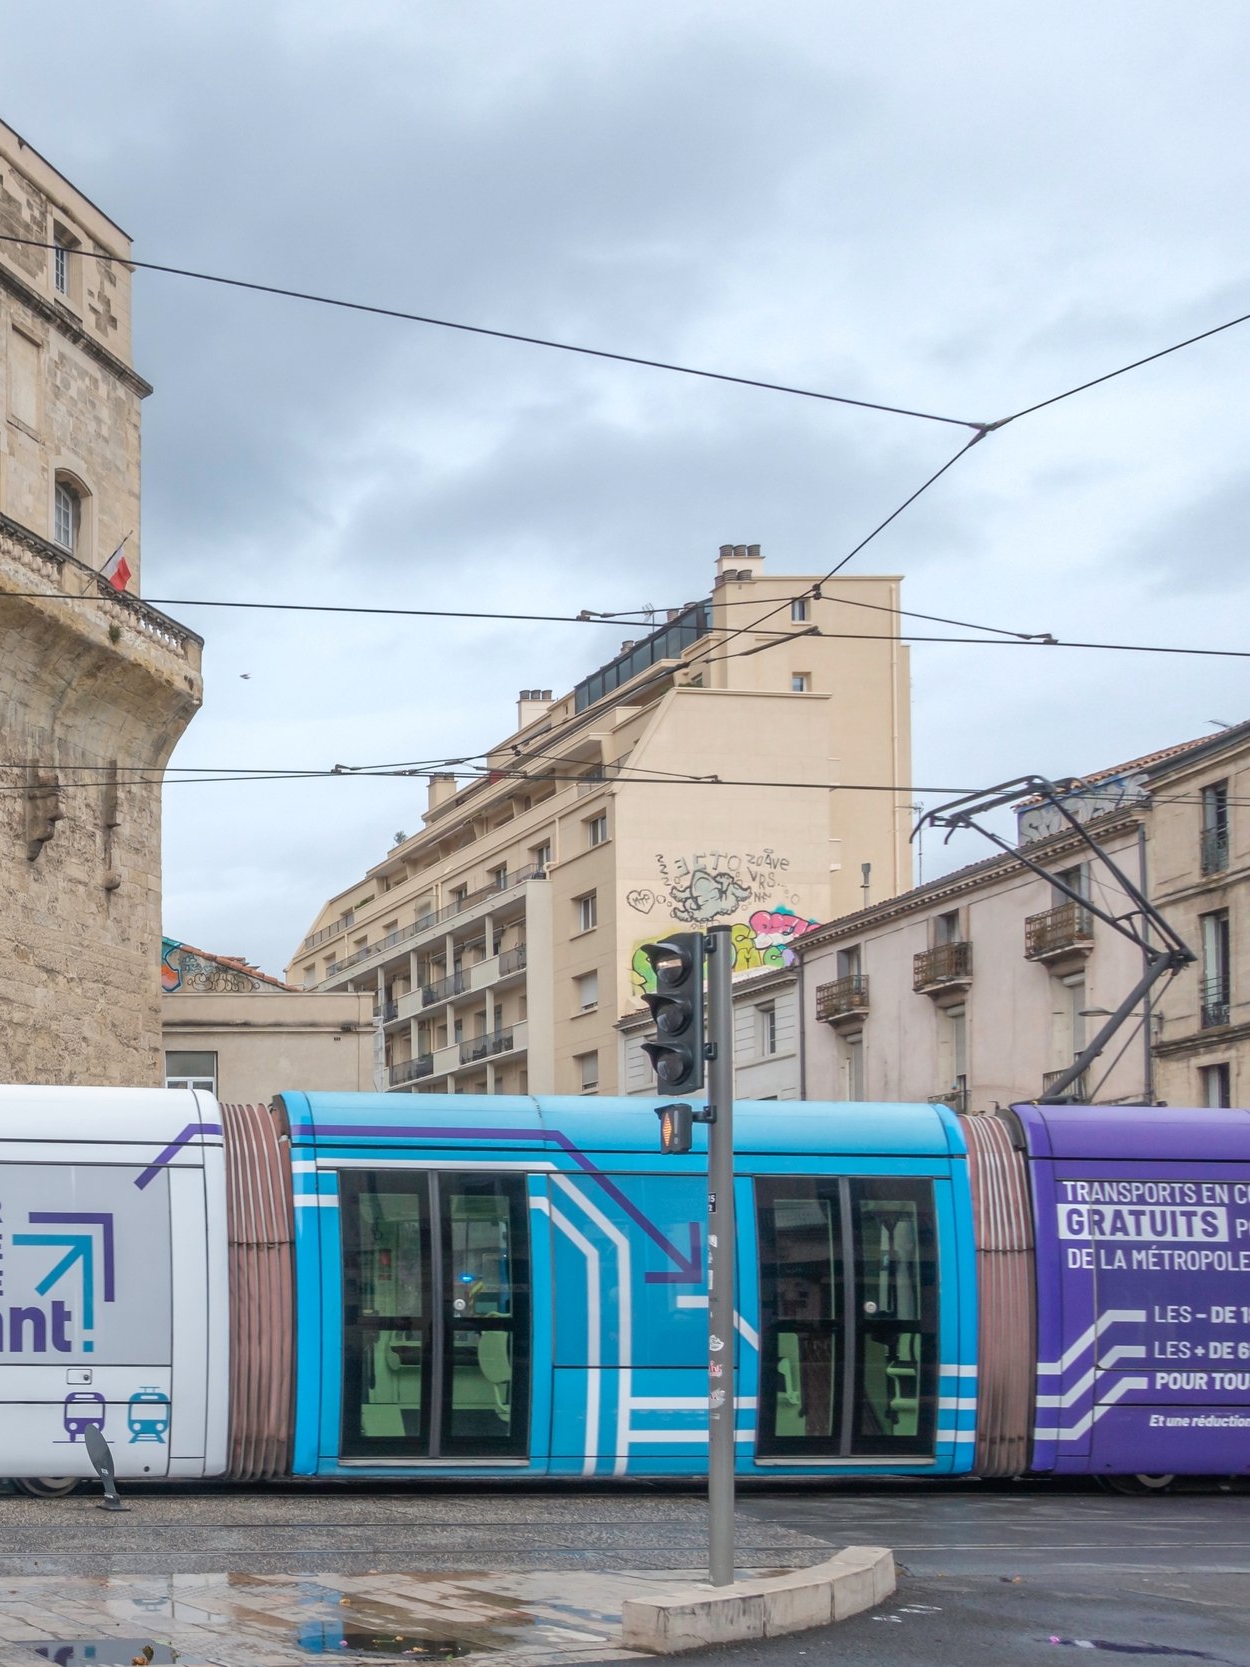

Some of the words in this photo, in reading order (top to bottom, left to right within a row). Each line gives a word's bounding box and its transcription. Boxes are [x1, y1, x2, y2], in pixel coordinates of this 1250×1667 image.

[1062, 1181, 1197, 1203] TRANSPORTS
[1202, 1184, 1229, 1204] EN
[1234, 1184, 1250, 1205] C
[1066, 1208, 1219, 1238] GRATUITS
[1235, 1218, 1250, 1239] P
[1067, 1248, 1094, 1269] DE
[1100, 1249, 1127, 1270] LA
[1132, 1245, 1250, 1271] MÉTROPOLE
[1154, 1306, 1192, 1323] LES
[1211, 1306, 1237, 1323] DE
[1240, 1306, 1250, 1324] 1
[1154, 1341, 1191, 1358] LES
[1194, 1345, 1206, 1357] +
[1208, 1341, 1235, 1359] DE
[1238, 1341, 1250, 1359] 6
[1155, 1372, 1208, 1390] POUR
[1149, 1414, 1165, 1427] Et
[1166, 1417, 1190, 1427] une
